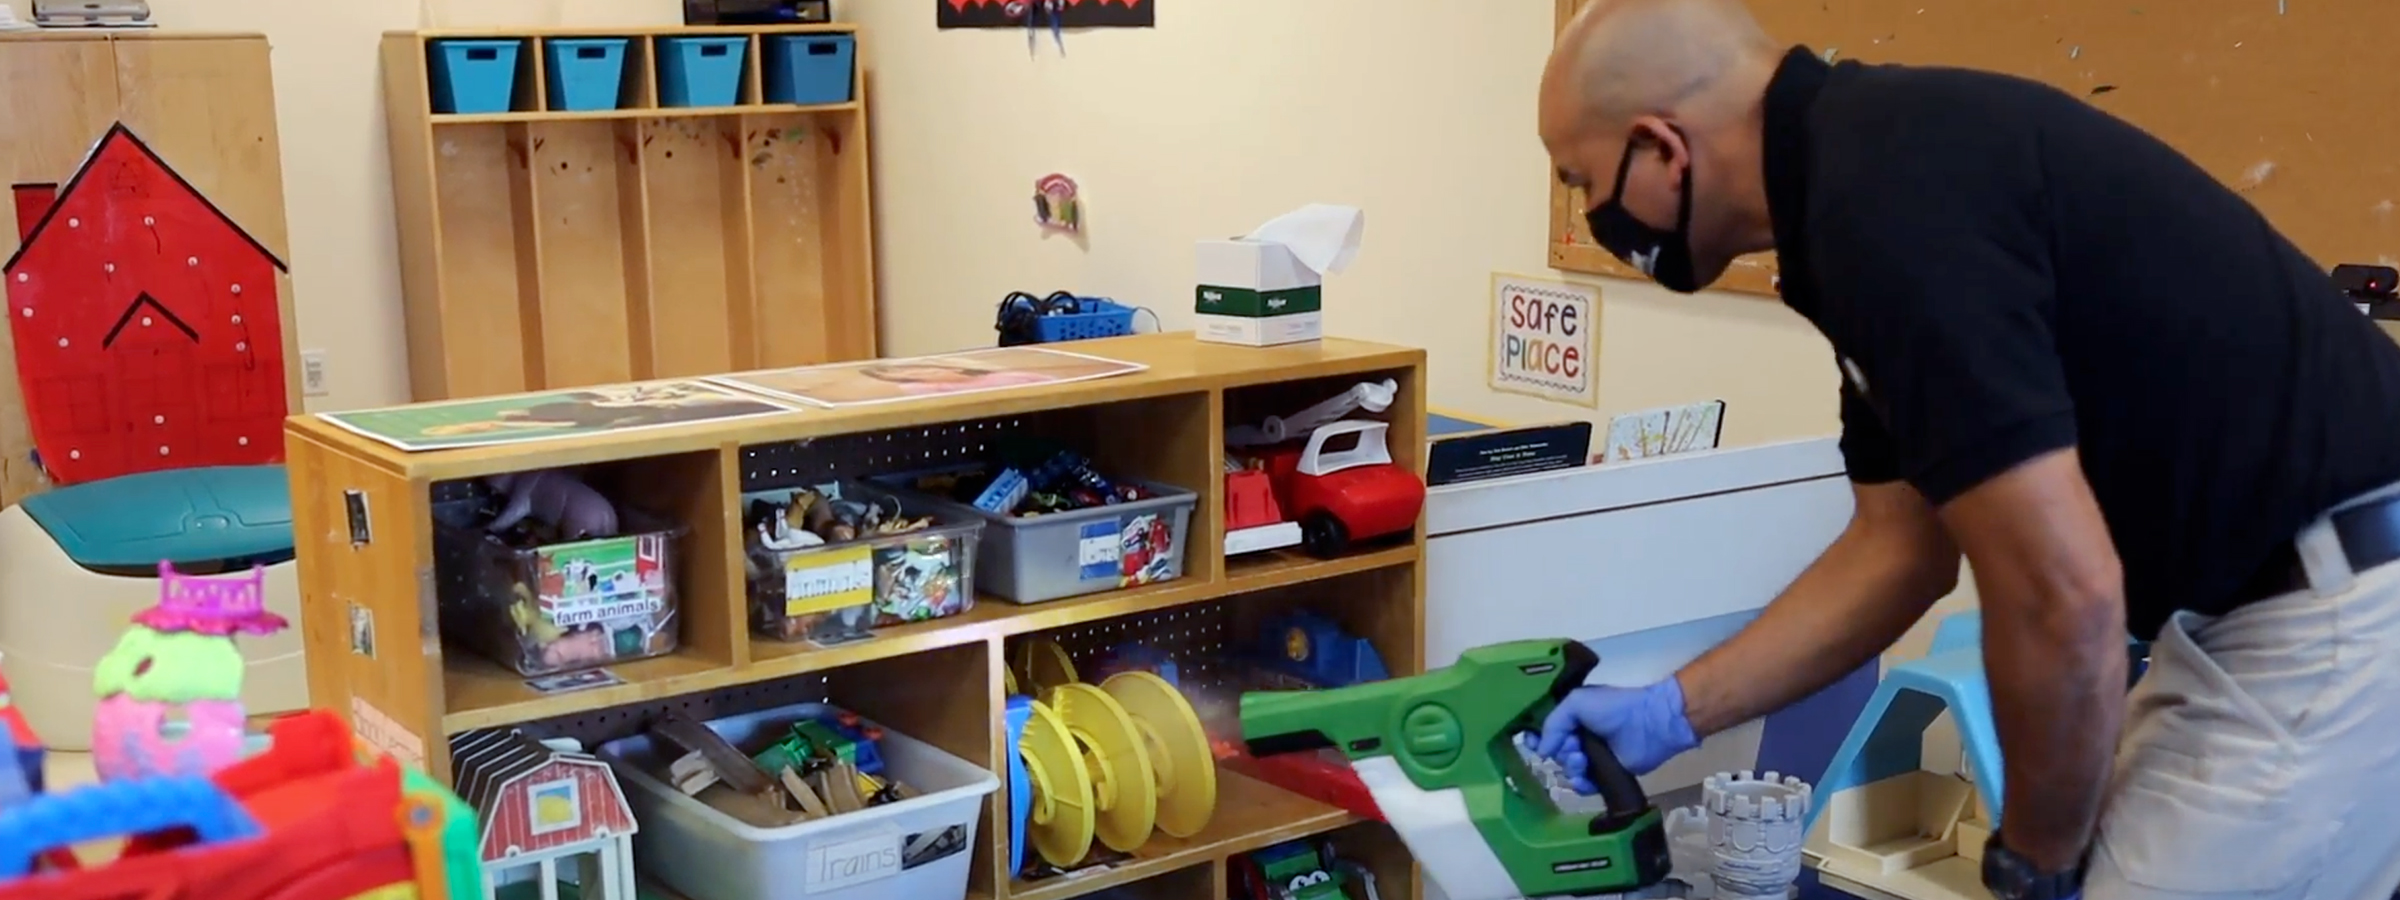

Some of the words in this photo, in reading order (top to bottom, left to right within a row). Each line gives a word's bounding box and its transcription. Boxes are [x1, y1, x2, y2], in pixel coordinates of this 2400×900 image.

[557, 609, 593, 625] farm
[597, 600, 659, 617] animals
[809, 842, 897, 882] Trains
